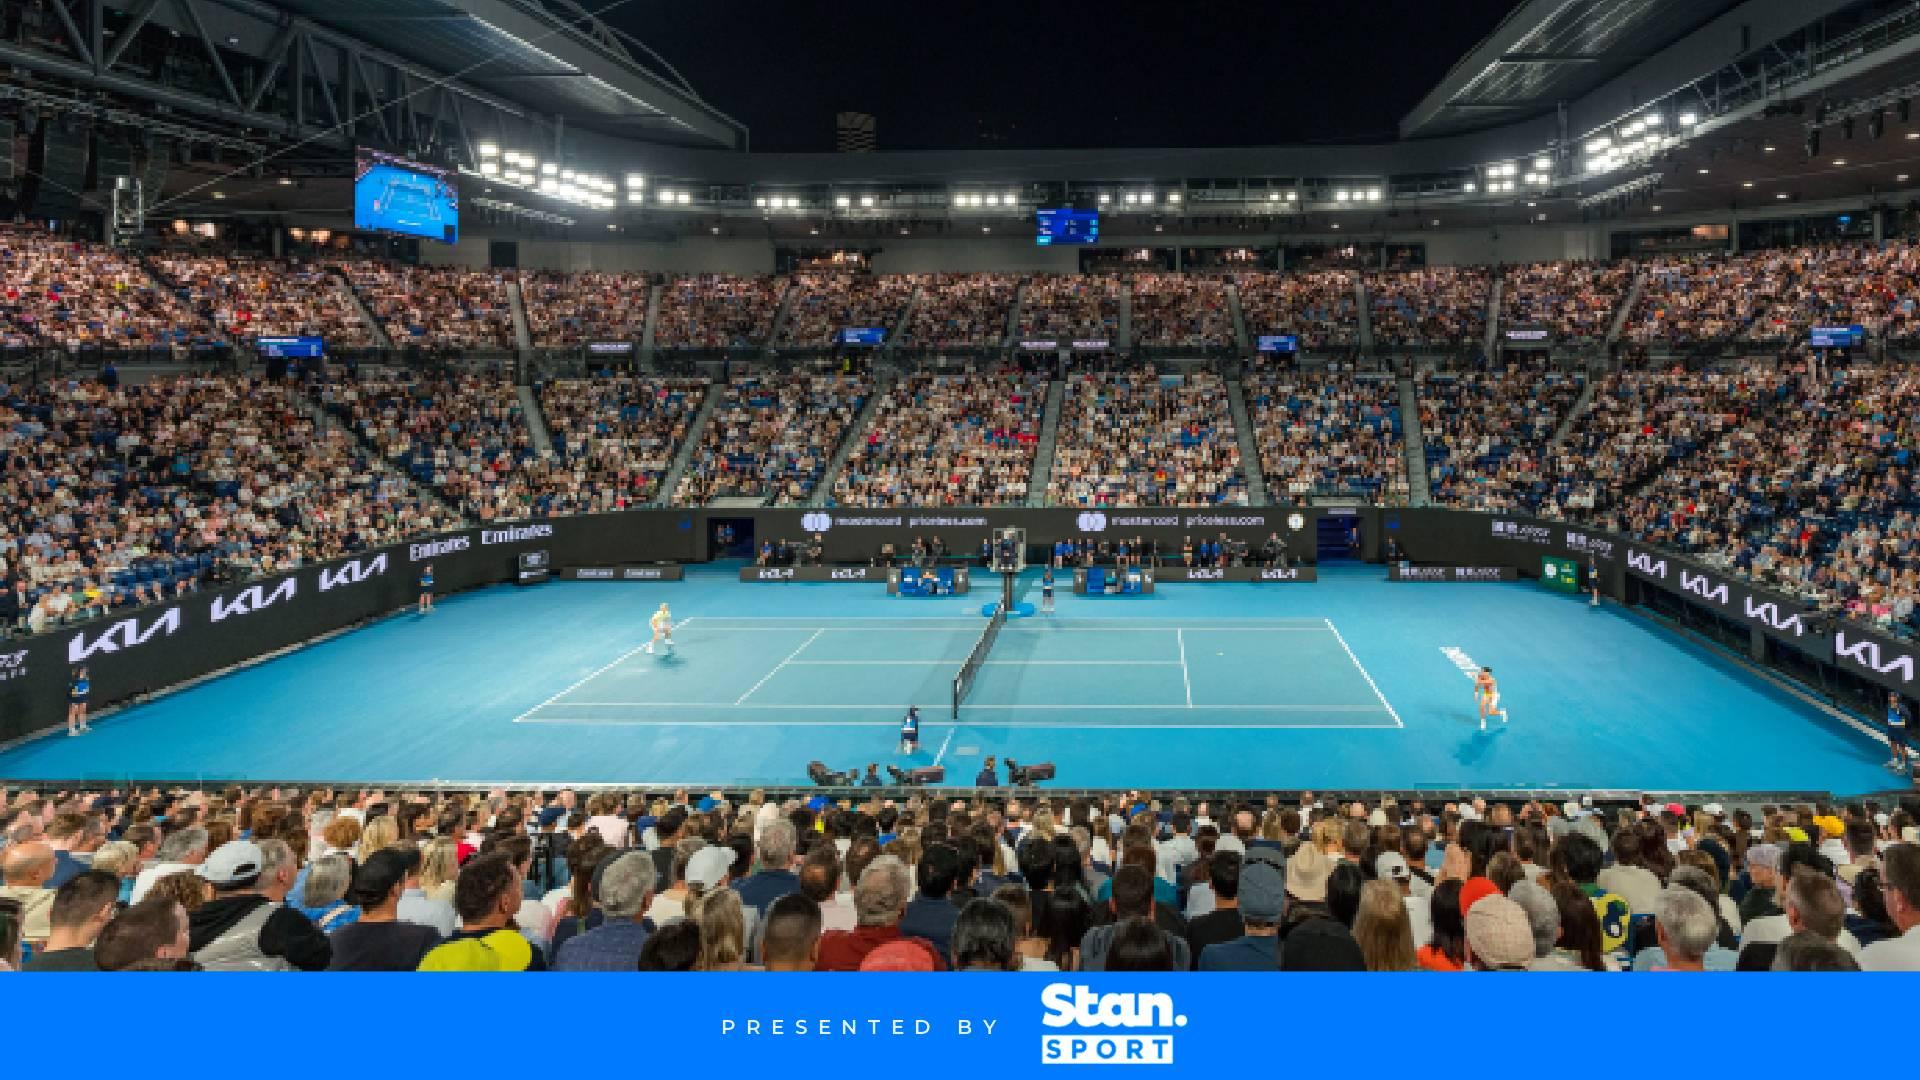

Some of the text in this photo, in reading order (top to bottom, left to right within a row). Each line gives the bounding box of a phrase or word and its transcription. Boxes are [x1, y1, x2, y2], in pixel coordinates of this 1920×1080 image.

[319, 553, 388, 592] KIA
[1628, 550, 1667, 578] KIA
[211, 578, 297, 622] KIA
[1680, 570, 1728, 604] KIA
[69, 607, 180, 664] KIA
[1744, 597, 1803, 636] KIA
[1836, 632, 1914, 682] KIA
